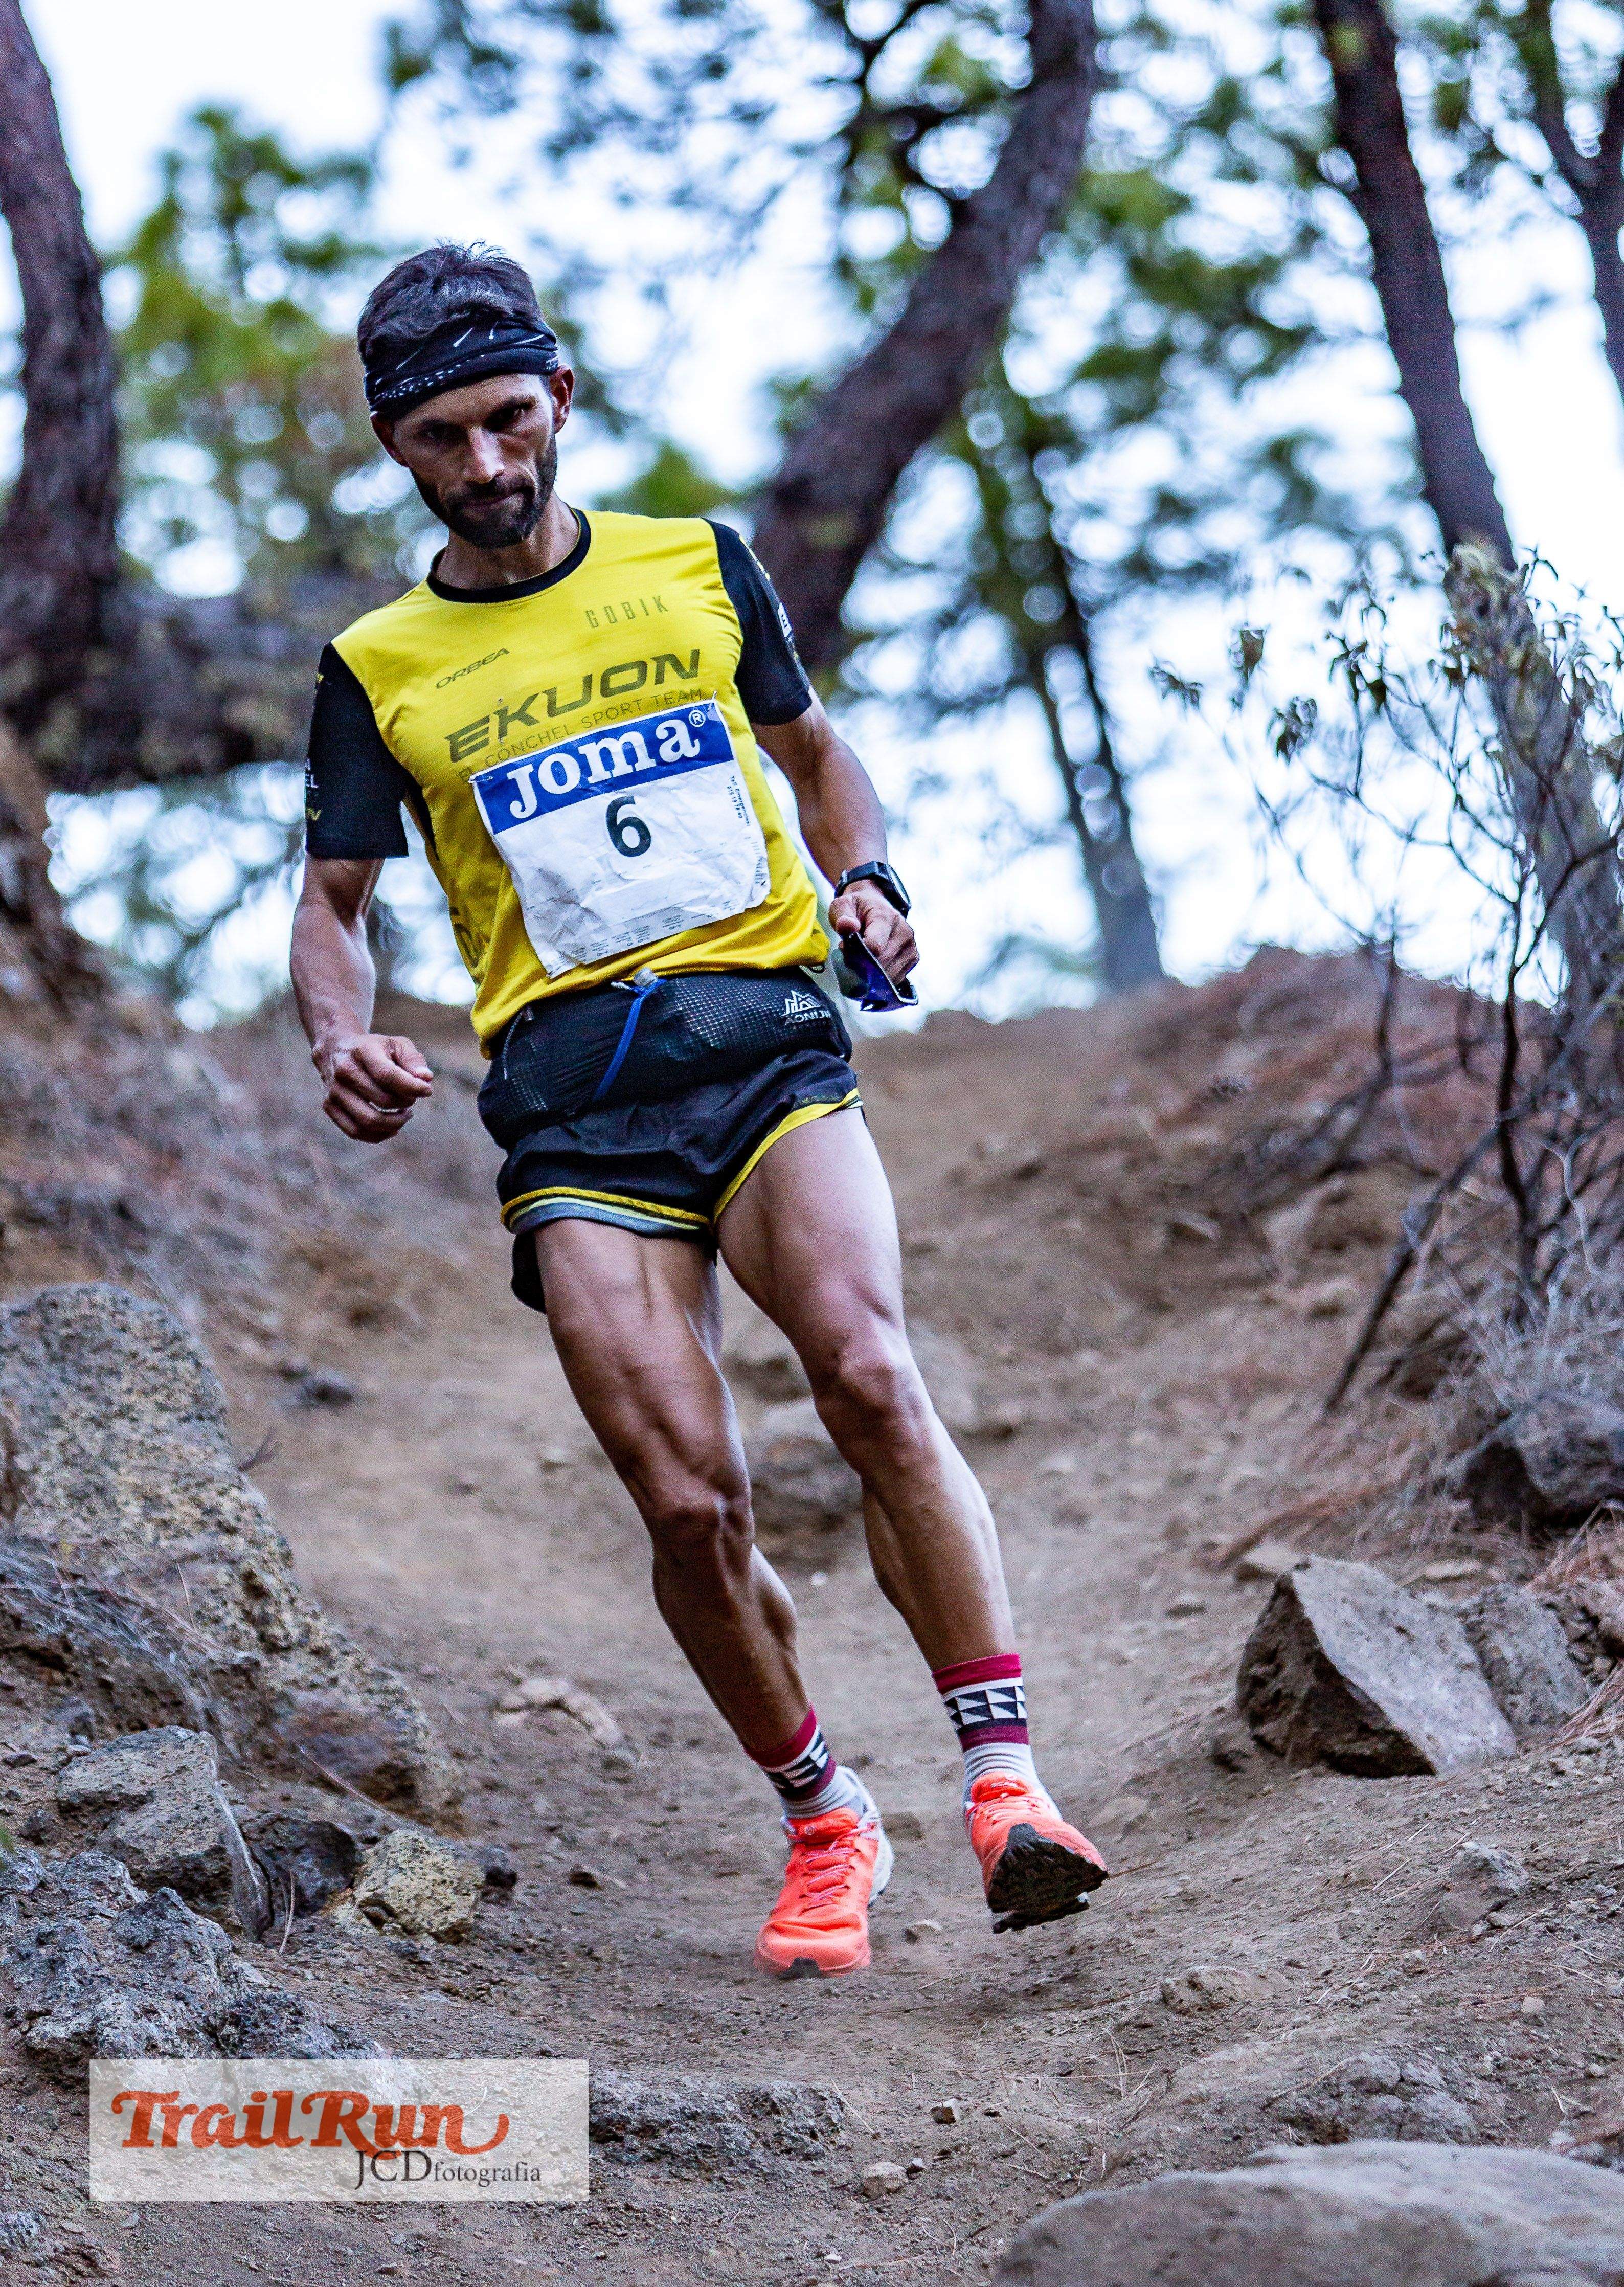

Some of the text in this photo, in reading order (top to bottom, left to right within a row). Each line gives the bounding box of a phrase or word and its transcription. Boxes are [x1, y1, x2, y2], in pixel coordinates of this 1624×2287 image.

[585, 596, 668, 628] GOBIK
[436, 648, 509, 689] ORBEA
[444, 649, 700, 763] EKUON
[485, 688, 702, 767] CONCHEL SPORT TEAM
[606, 796, 652, 858] 6
